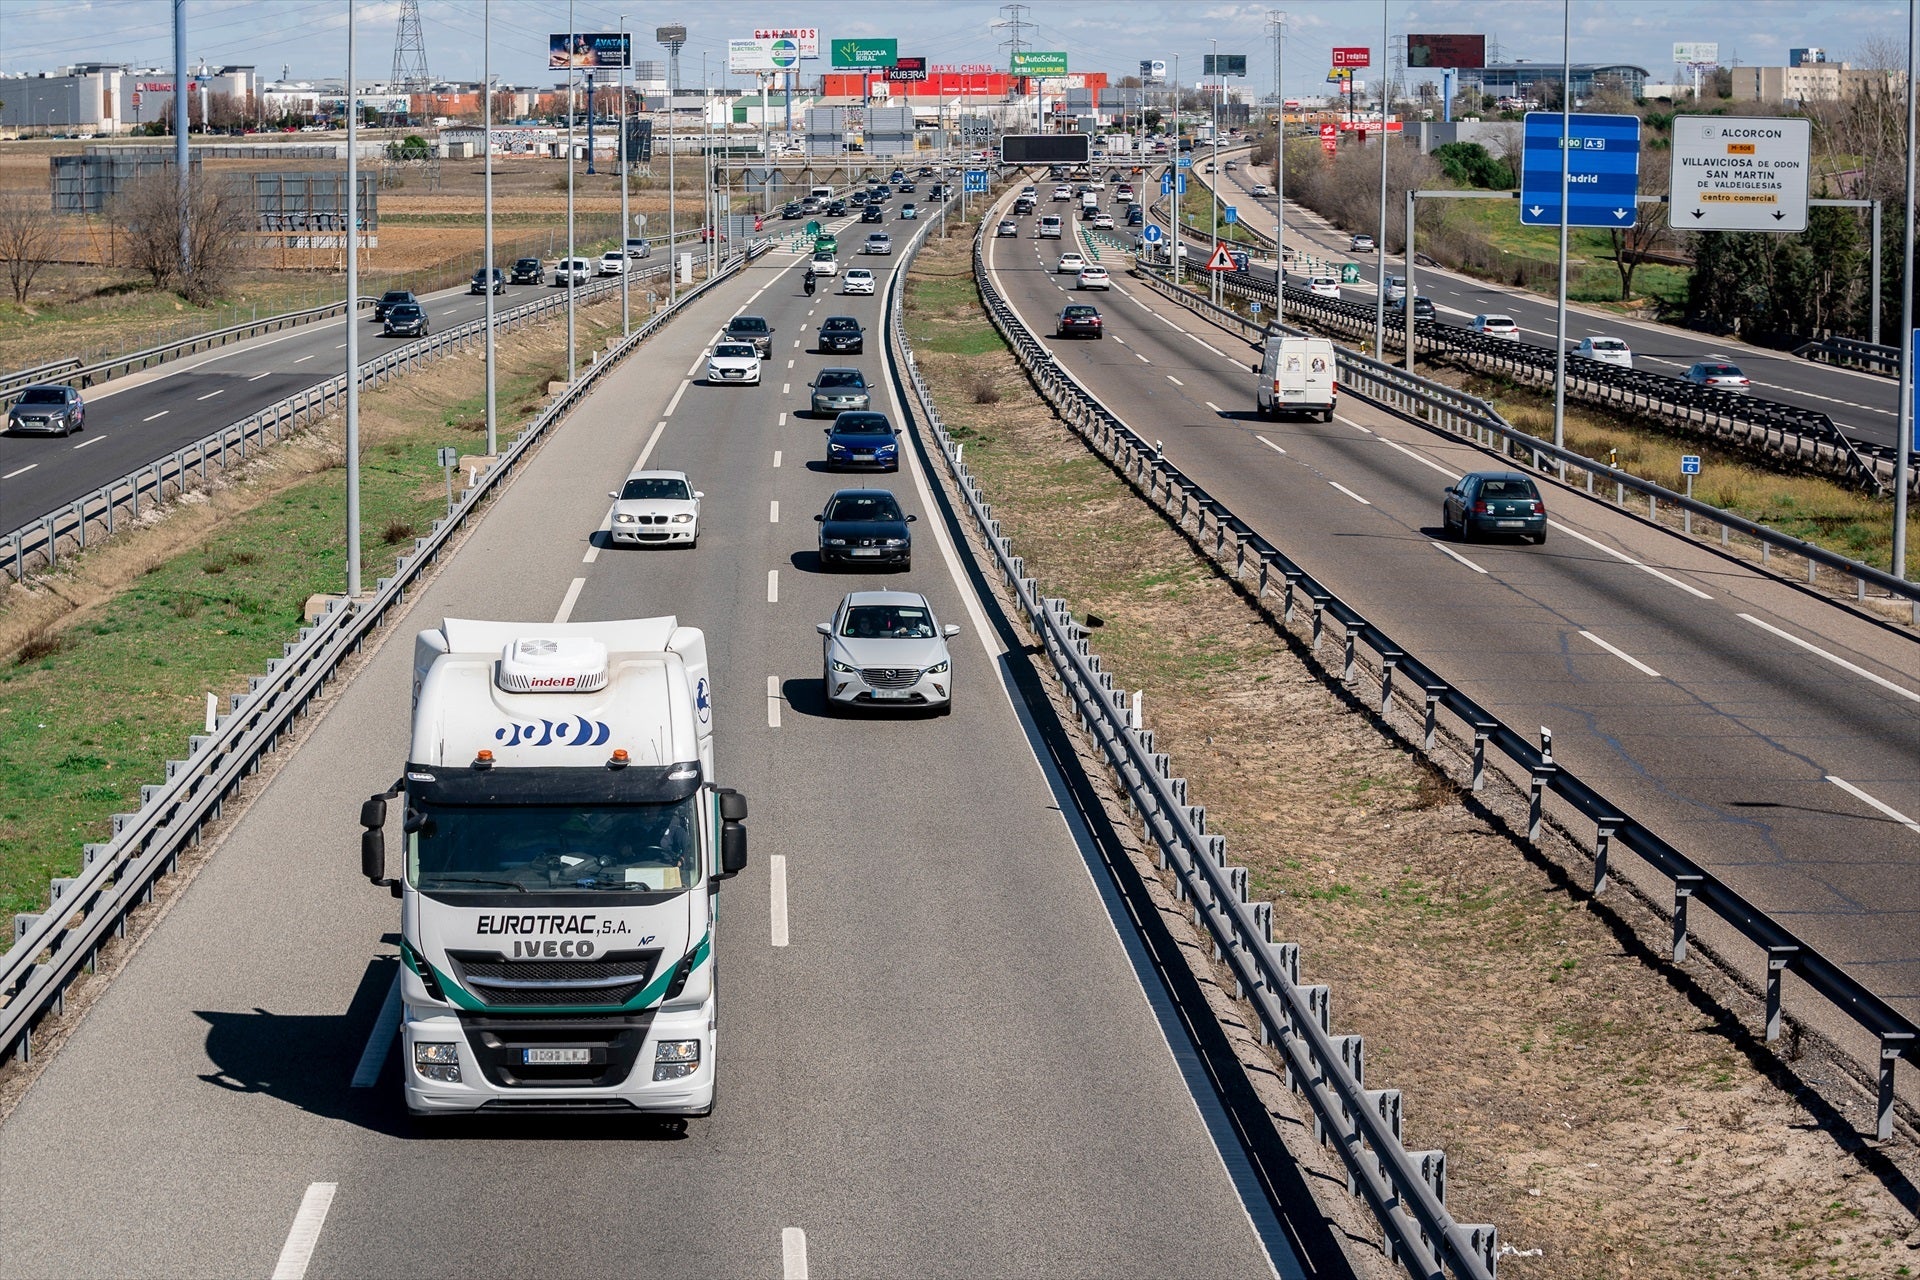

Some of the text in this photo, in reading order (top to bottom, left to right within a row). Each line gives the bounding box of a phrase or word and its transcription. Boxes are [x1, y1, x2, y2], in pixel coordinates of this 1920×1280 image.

[595, 38, 629, 46] AVATAR
[960, 64, 992, 72] CHINA
[1721, 129, 1782, 138] ALCORCON
[1682, 157, 1800, 169] VILLAVICIOSA DE ODON
[1706, 170, 1775, 180] SAN MARTIN
[1697, 180, 1782, 190] DE VALDEIGLESIAS
[1734, 194, 1776, 203] comercial
[1687, 464, 1694, 472] 6
[513, 940, 595, 958] IVECO
